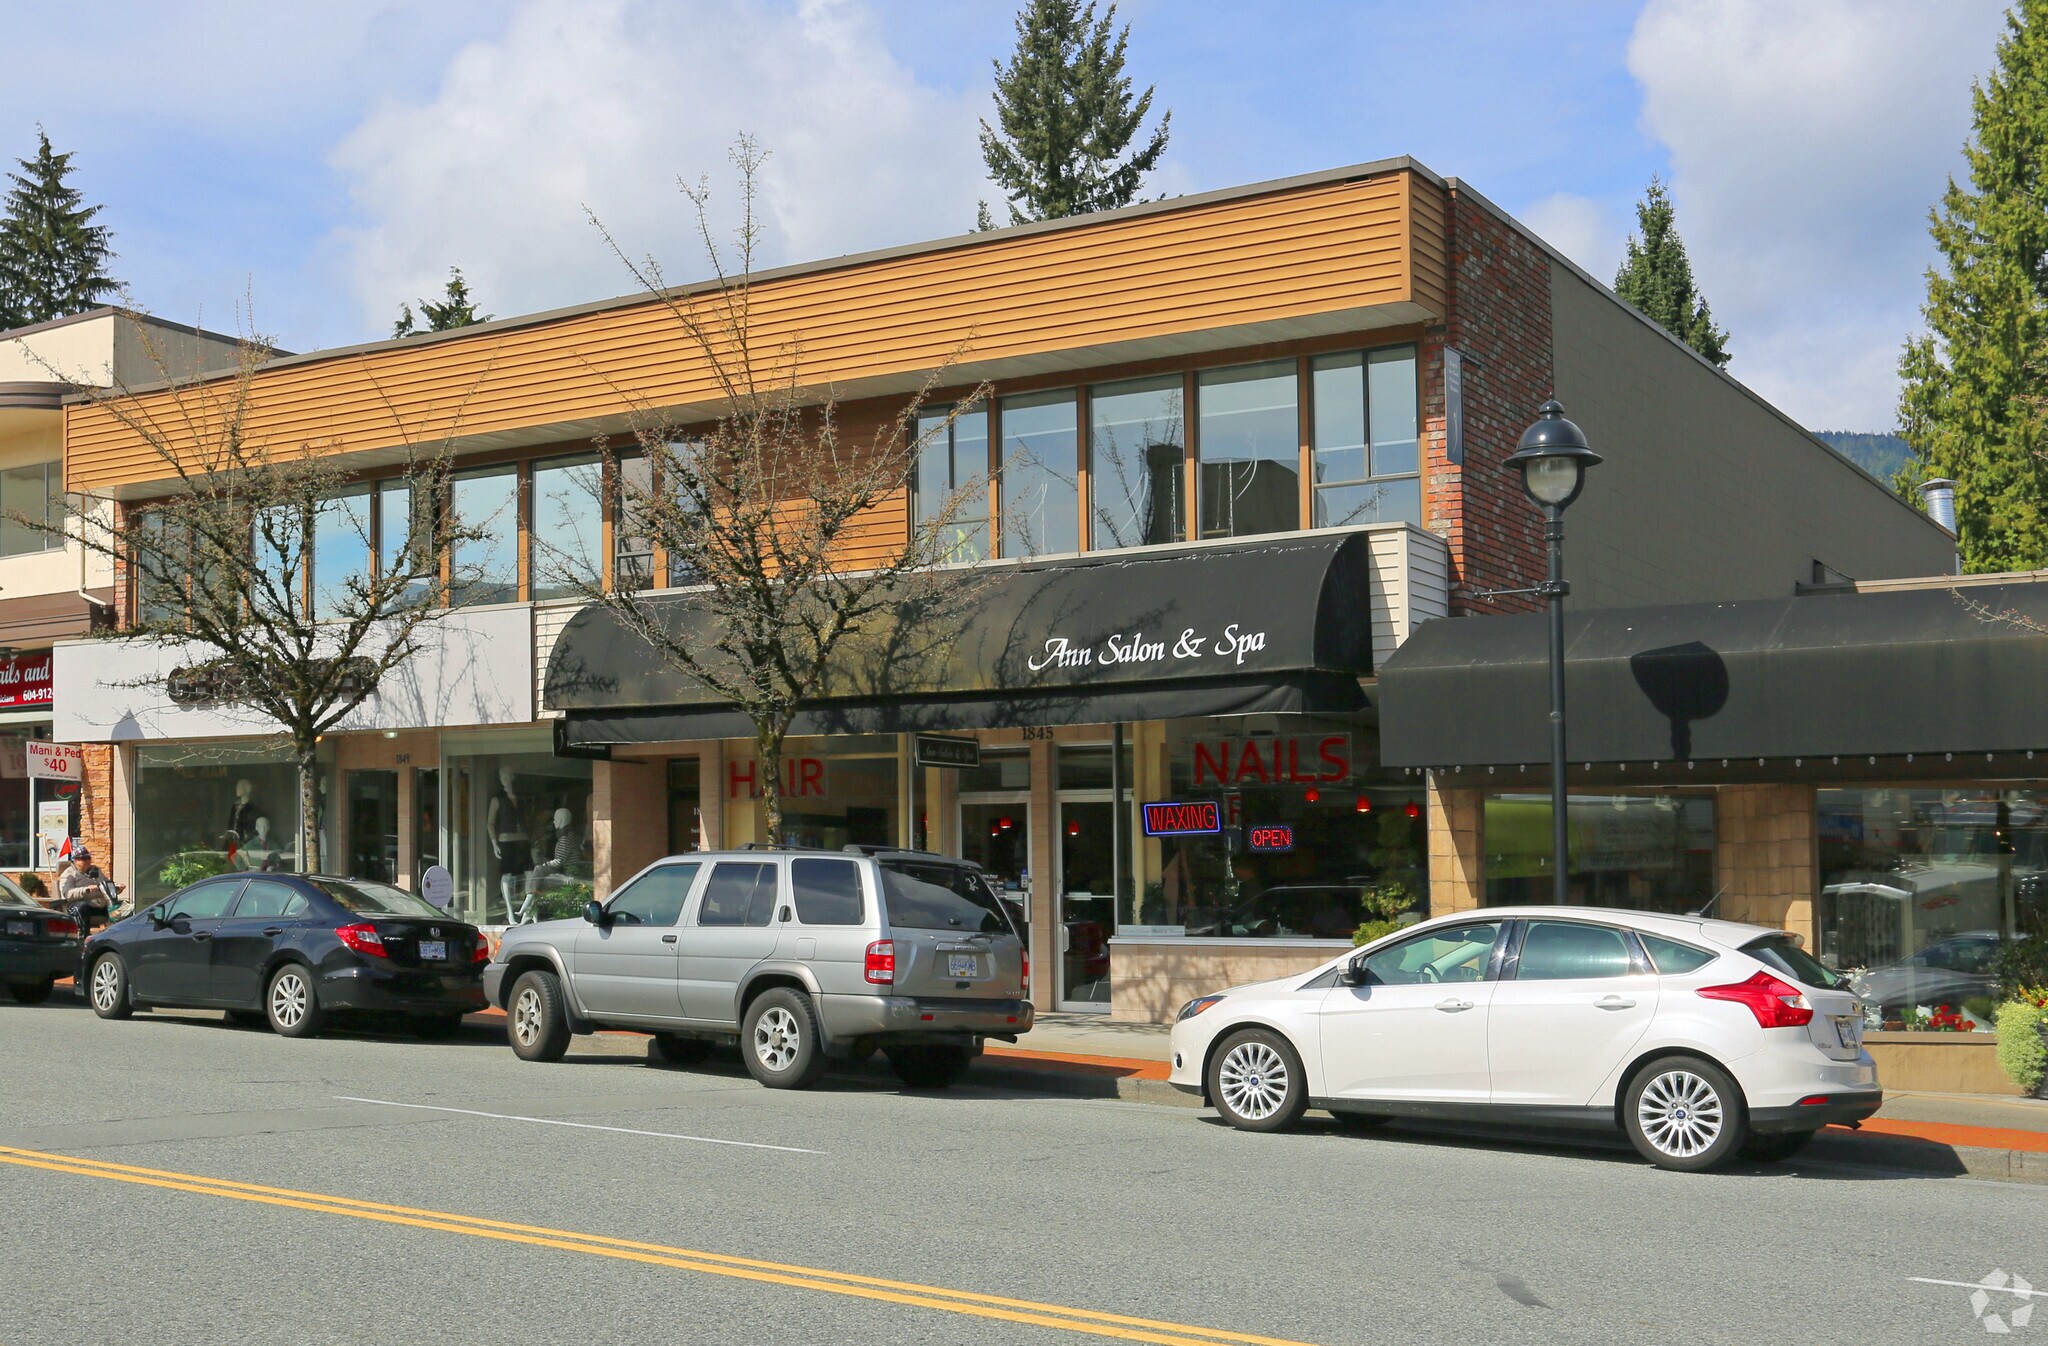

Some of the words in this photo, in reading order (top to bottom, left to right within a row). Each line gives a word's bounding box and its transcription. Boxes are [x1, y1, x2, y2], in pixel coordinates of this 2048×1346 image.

[1028, 638, 1092, 671] Ann
[1098, 633, 1165, 665] Salon
[1173, 628, 1207, 659] &
[1215, 624, 1266, 666] Spa
[24, 657, 50, 682] and
[1022, 727, 1054, 741] 1845
[30, 745, 52, 756] Mani
[55, 747, 61, 756] &
[44, 758, 67, 773] $40
[1194, 737, 1350, 786] NAILS
[1148, 804, 1216, 831] WAXING
[1252, 829, 1291, 847] OPEN
